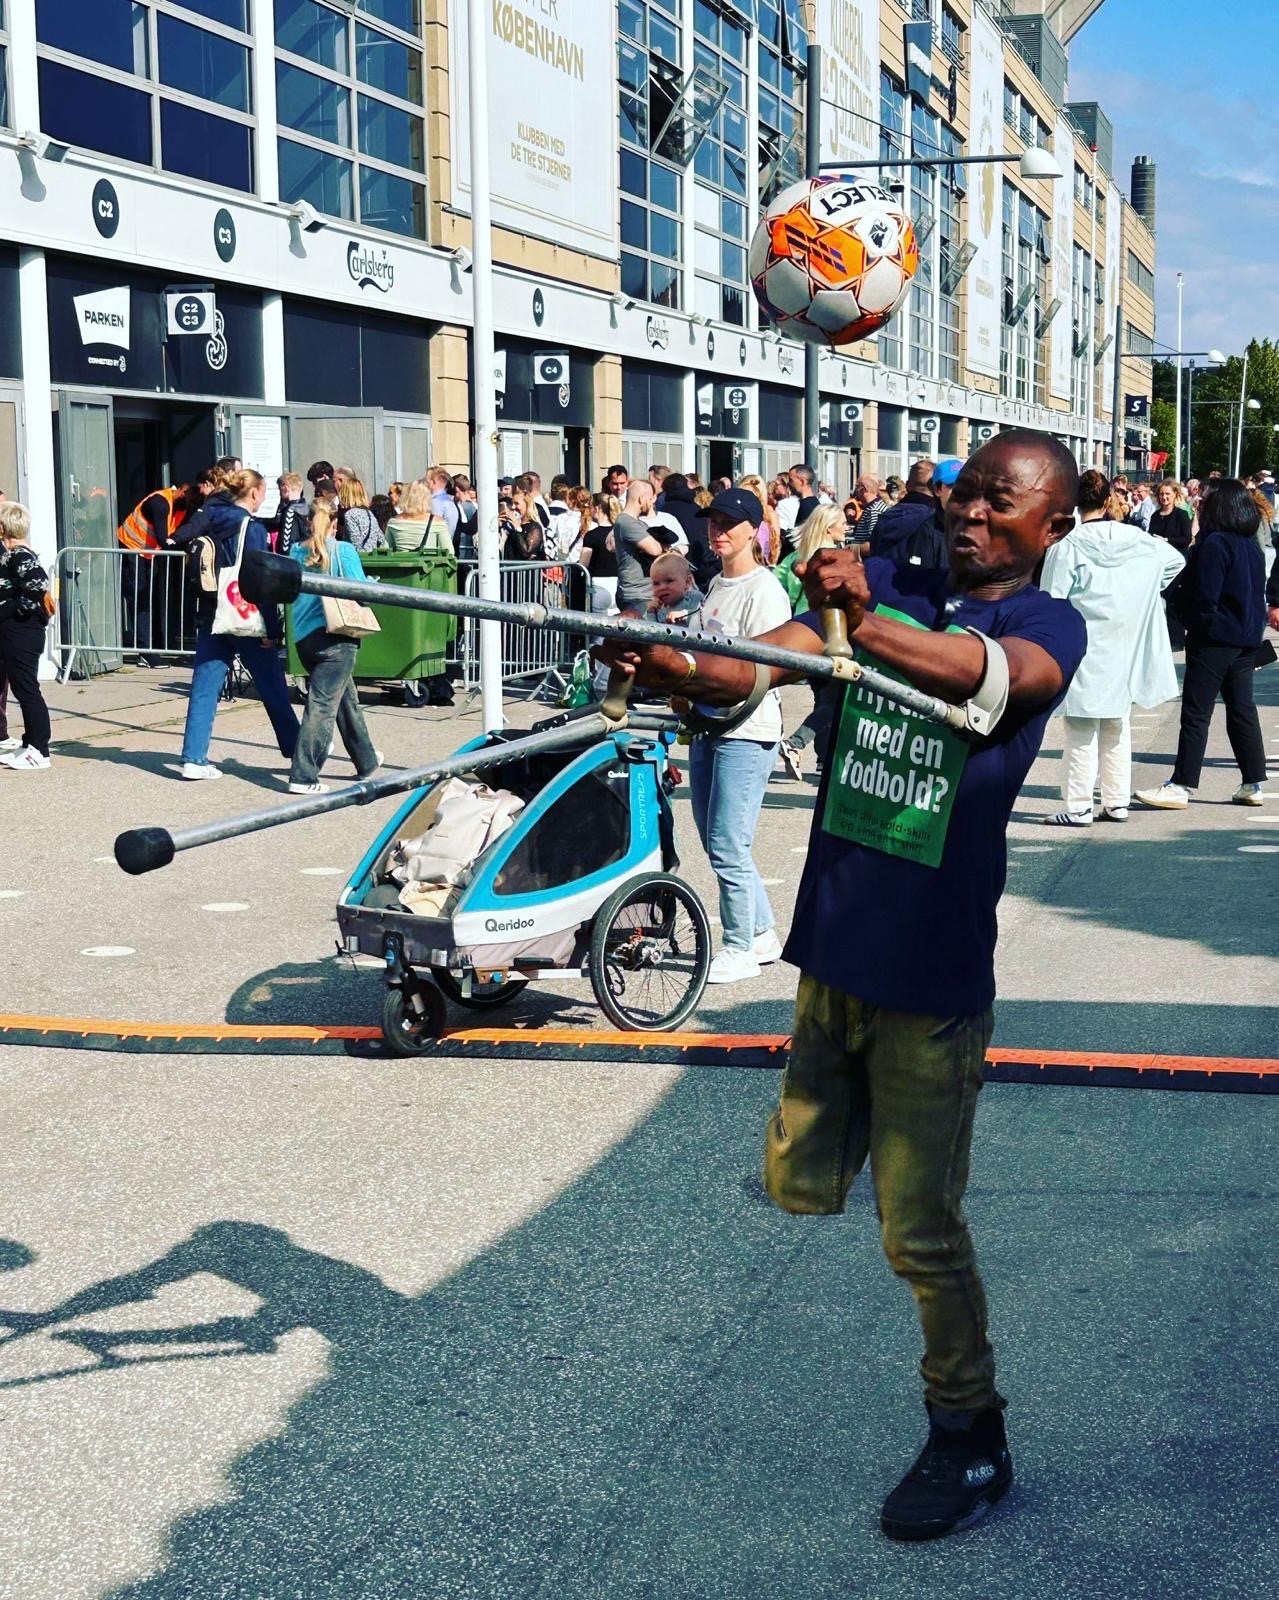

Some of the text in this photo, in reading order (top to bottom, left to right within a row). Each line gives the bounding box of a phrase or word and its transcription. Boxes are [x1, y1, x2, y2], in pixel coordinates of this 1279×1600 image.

[493, 0, 583, 82] KØBENHAVN
[517, 121, 565, 157] KLUBBEN MED
[511, 142, 571, 182] DE TRE STJERNER
[98, 199, 114, 218] C2
[820, 186, 896, 216] SELECT
[218, 227, 232, 244] C3
[347, 241, 394, 288] Carlsberg
[182, 303, 199, 314] C2
[84, 310, 125, 328] PARKEN
[183, 315, 199, 326] C3
[545, 366, 558, 374] C4
[1131, 401, 1141, 412] S
[856, 717, 944, 769] med en
[840, 750, 949, 813] fodbold?
[485, 918, 534, 932] Qeridoo
[966, 1464, 994, 1481] PARIS
